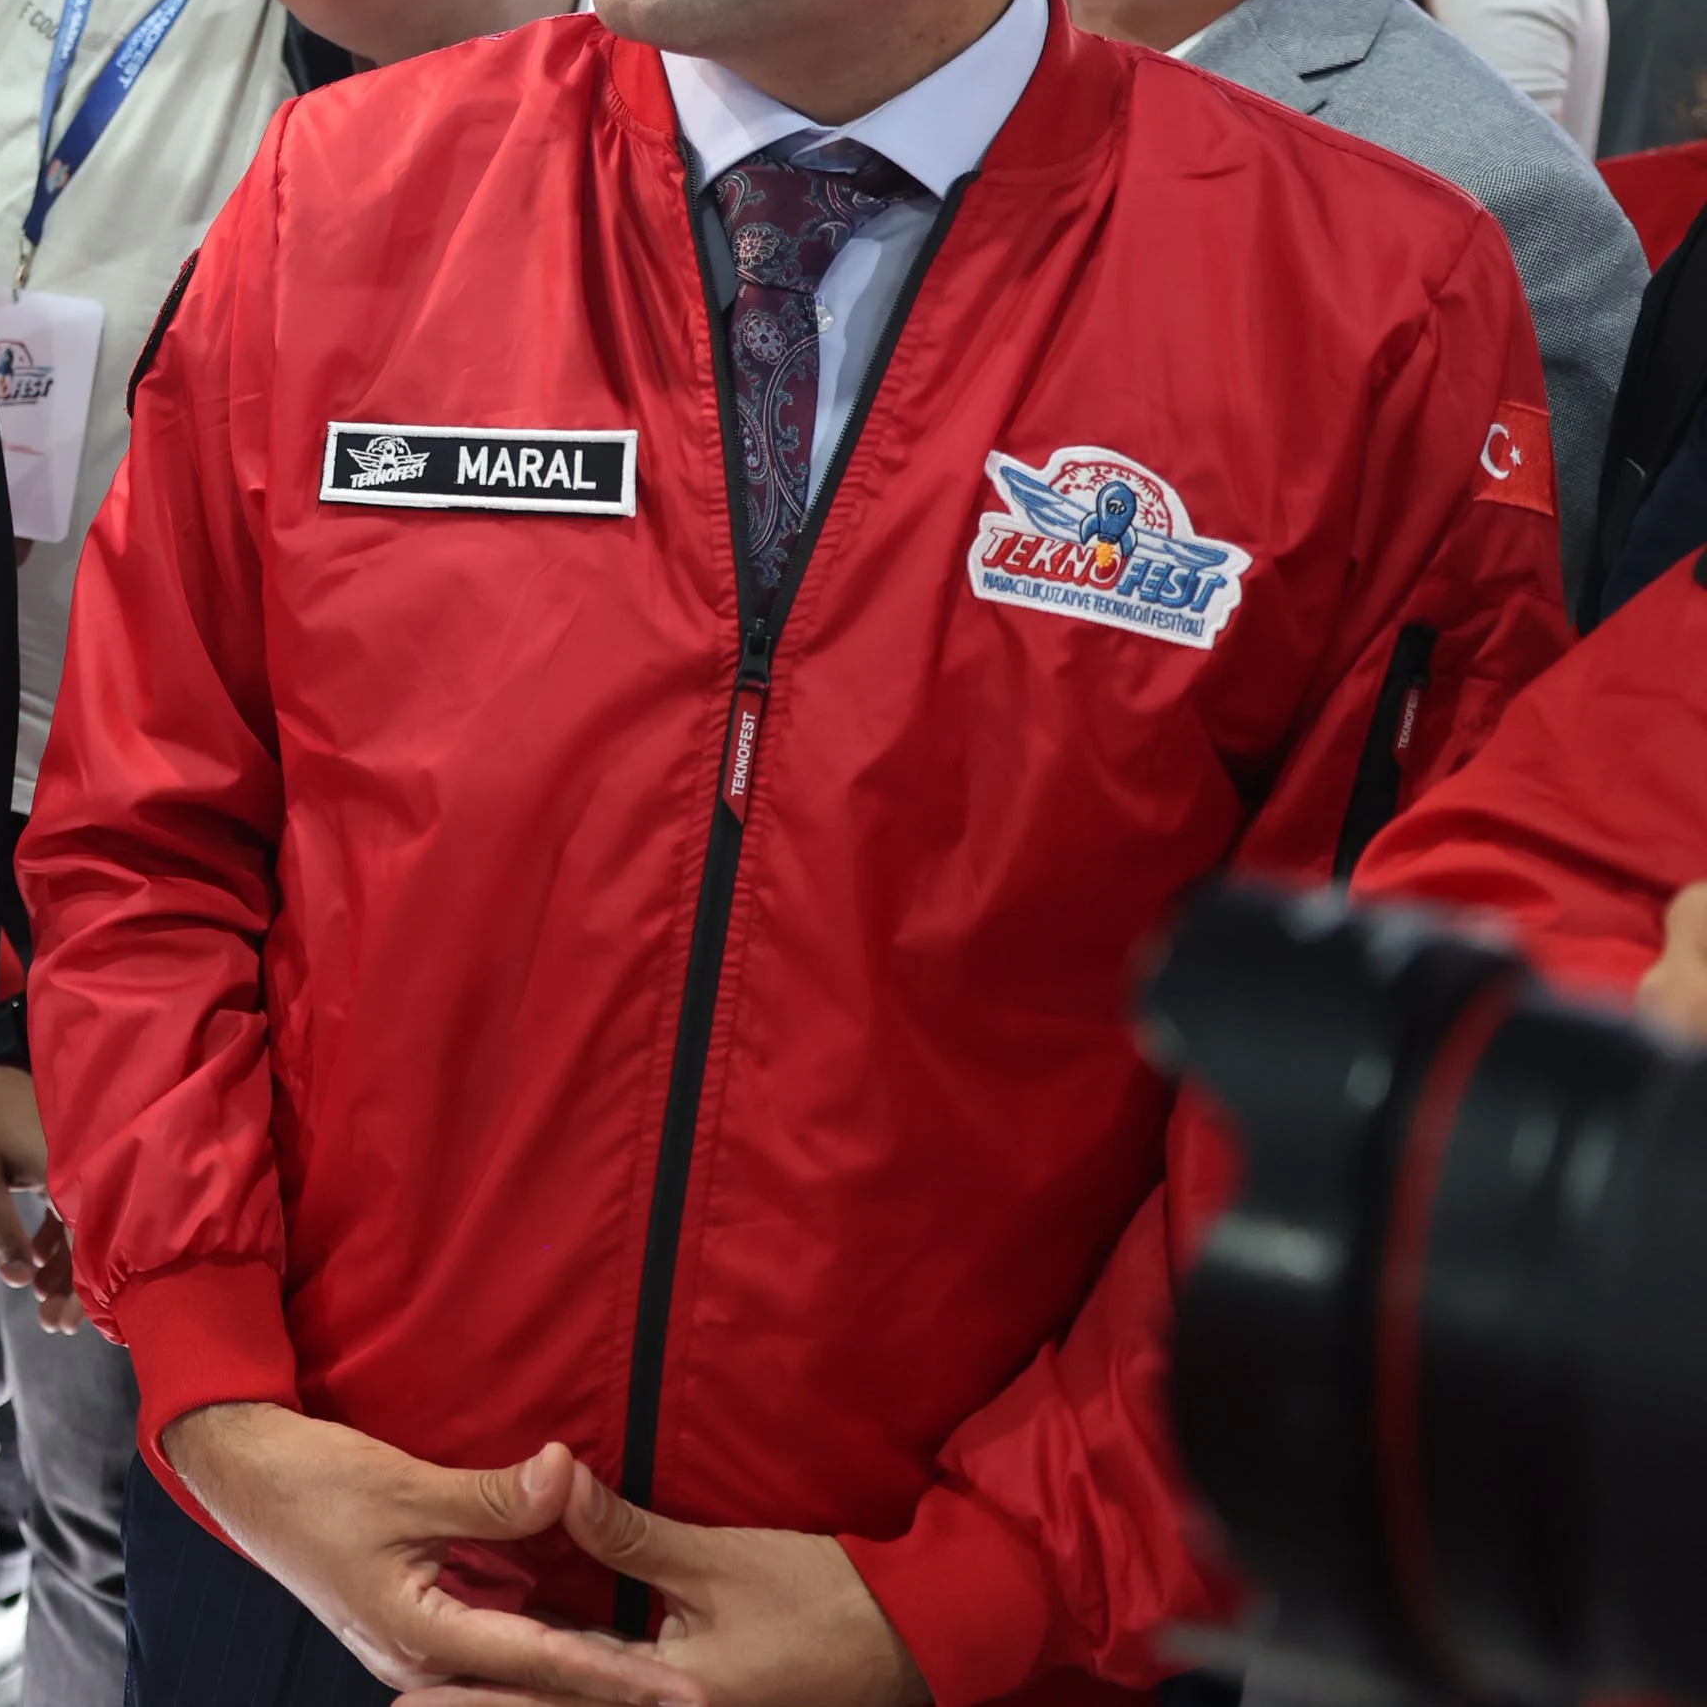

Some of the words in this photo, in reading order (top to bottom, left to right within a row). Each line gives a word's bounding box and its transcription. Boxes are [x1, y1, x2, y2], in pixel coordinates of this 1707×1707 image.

[350, 461, 427, 489] TEKNOFEST
[457, 445, 597, 491] MARAL
[982, 527, 1227, 612] TEKNOFEST
[731, 711, 756, 796] TEKNOFEST
